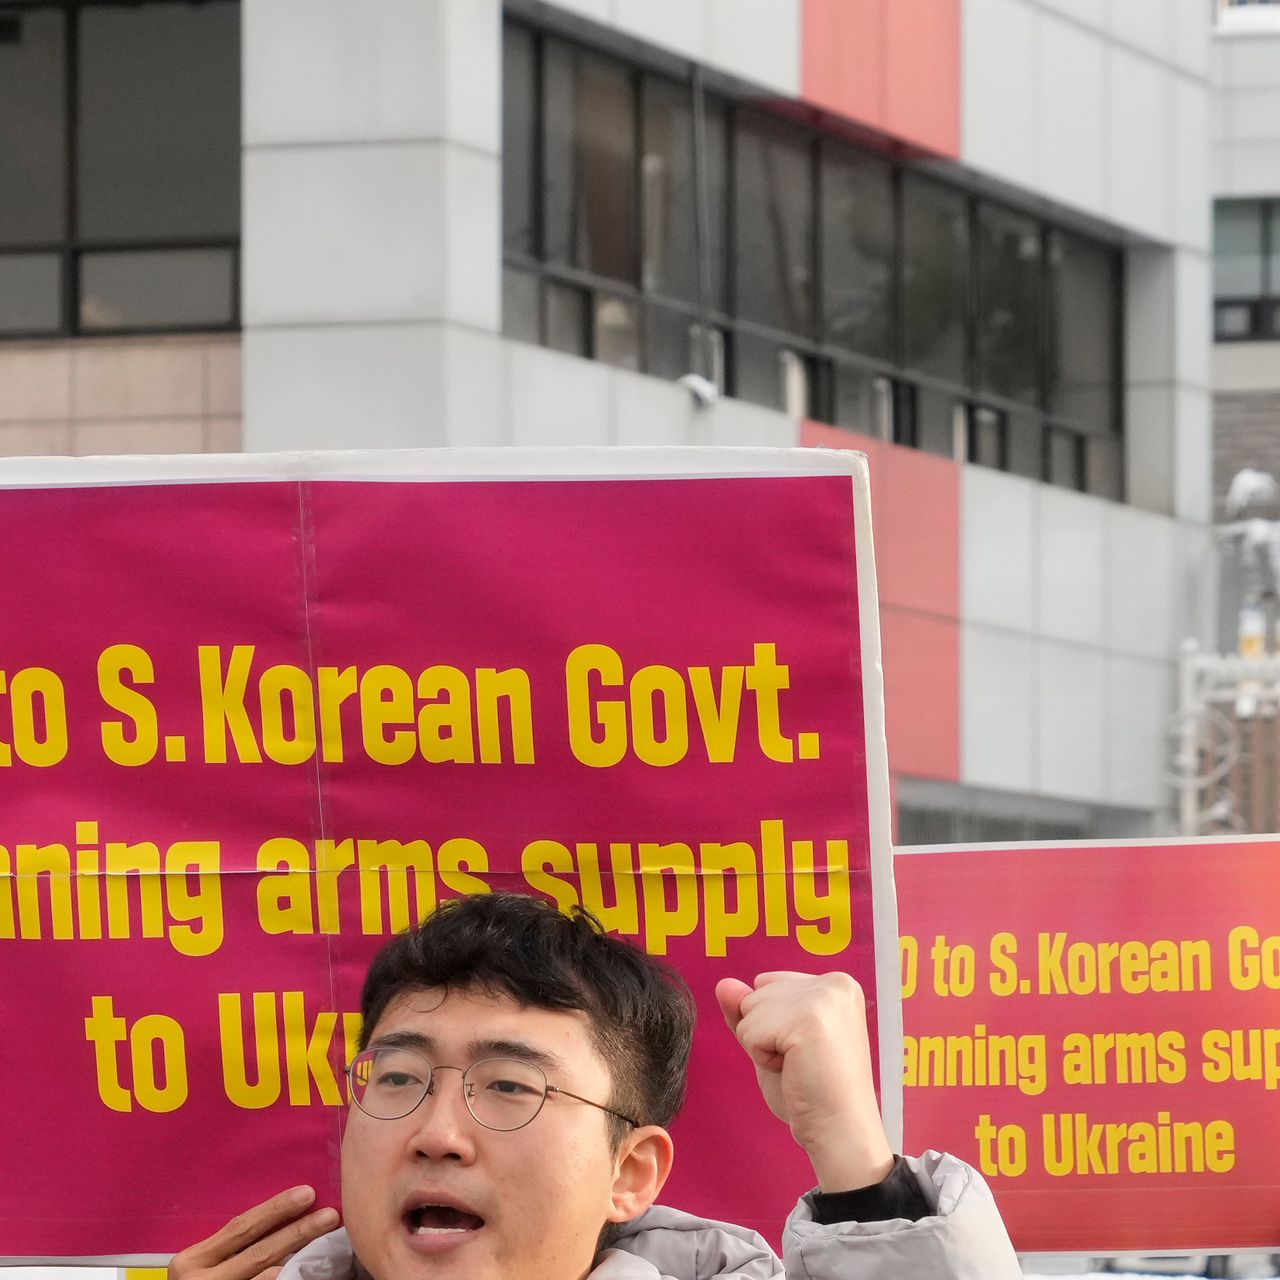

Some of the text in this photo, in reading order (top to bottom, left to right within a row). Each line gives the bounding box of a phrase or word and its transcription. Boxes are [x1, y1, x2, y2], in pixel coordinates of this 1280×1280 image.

[567, 644, 819, 767] Govt.
[257, 838, 490, 934] arms
[522, 820, 851, 956] supply
[900, 936, 918, 998] O
[931, 936, 975, 997] to
[85, 997, 187, 1112] to
[903, 1025, 1046, 1095] anning
[1063, 1031, 1186, 1084] arms
[976, 1112, 1235, 1176] to Ukraine
